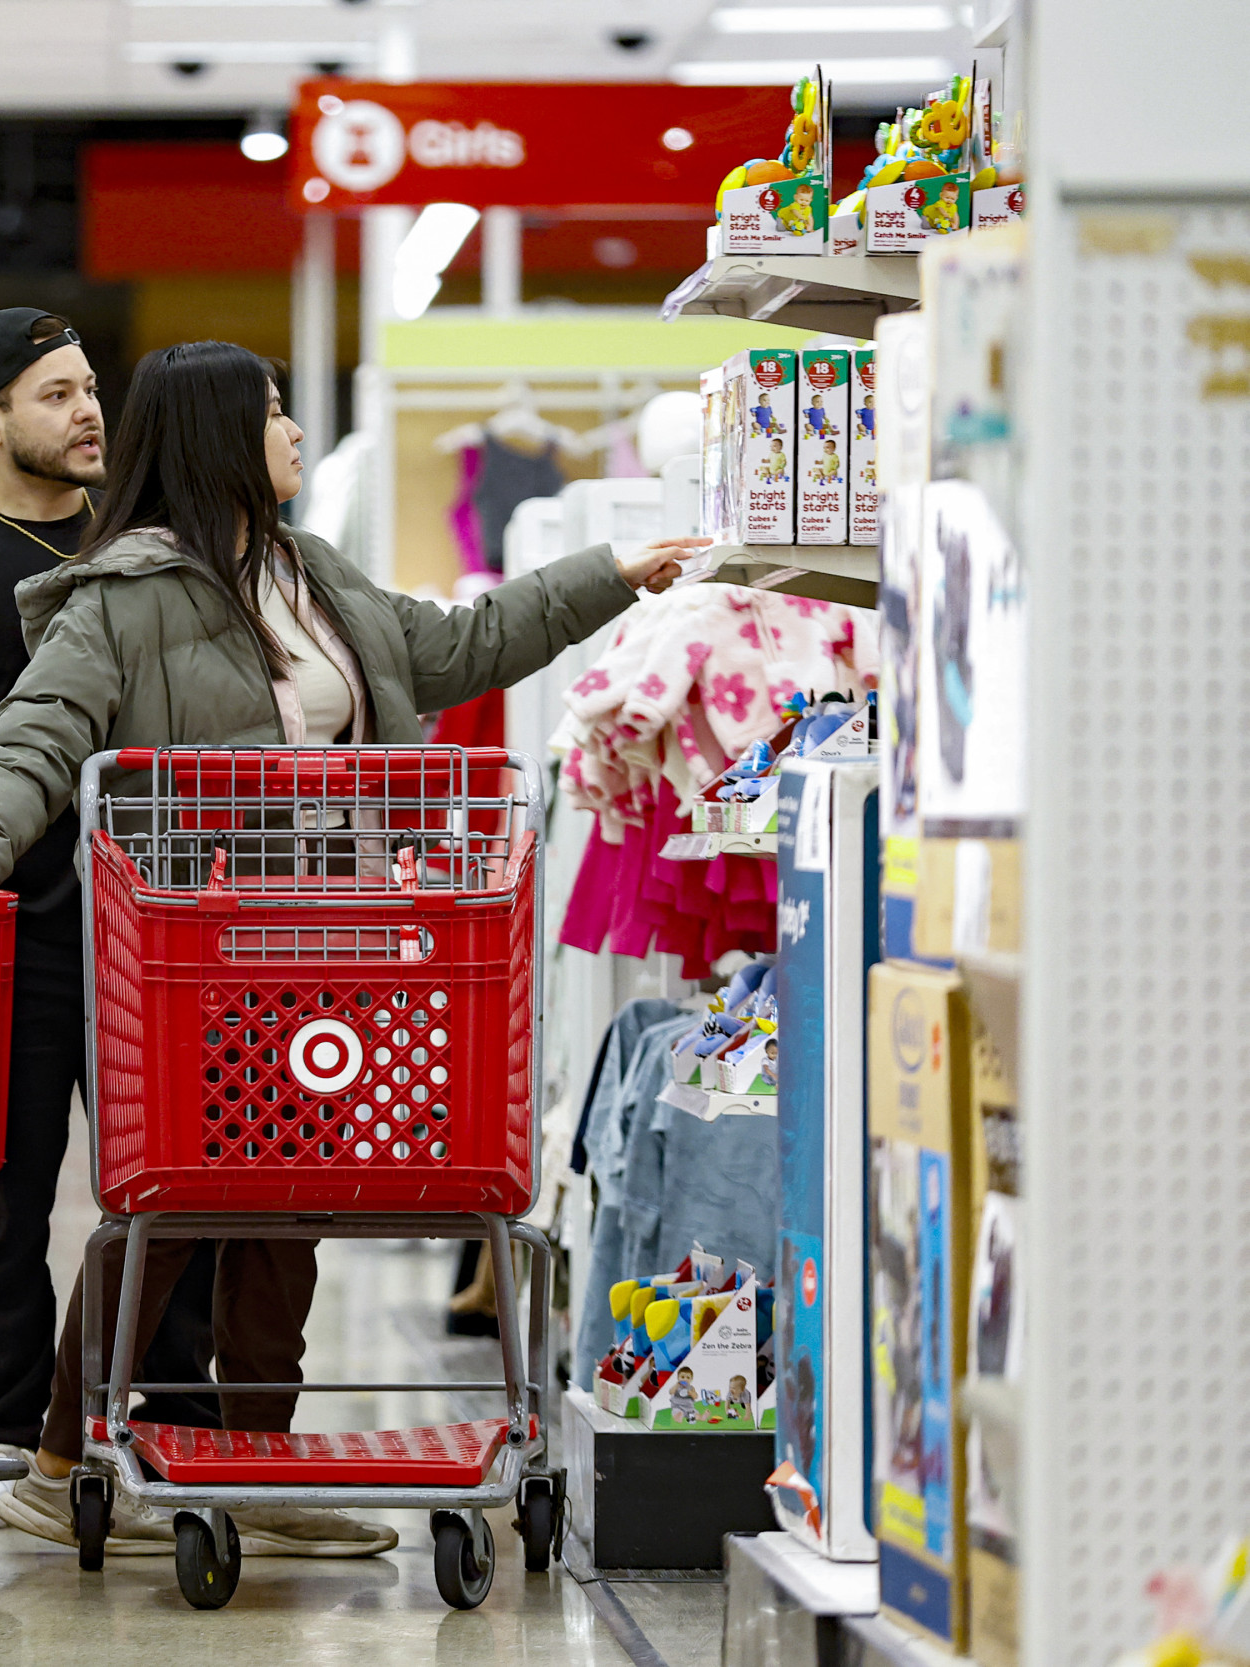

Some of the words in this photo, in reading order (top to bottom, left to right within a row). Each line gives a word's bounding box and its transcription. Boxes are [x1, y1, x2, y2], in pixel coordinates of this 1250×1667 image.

[409, 120, 526, 168] Girls
[764, 191, 775, 201] 4
[910, 188, 920, 198] 4
[1013, 192, 1023, 202] 4
[730, 213, 760, 224] bright
[874, 210, 905, 221] bright
[978, 214, 1008, 225] bright
[729, 223, 760, 231] starts
[874, 220, 905, 228] starts
[761, 361, 777, 372] 18
[813, 362, 830, 374] 18
[750, 490, 786, 502] bright
[803, 491, 839, 504] bright
[855, 491, 878, 504] brig
[749, 501, 786, 511] starts
[802, 502, 839, 512] starts
[855, 503, 878, 513] star
